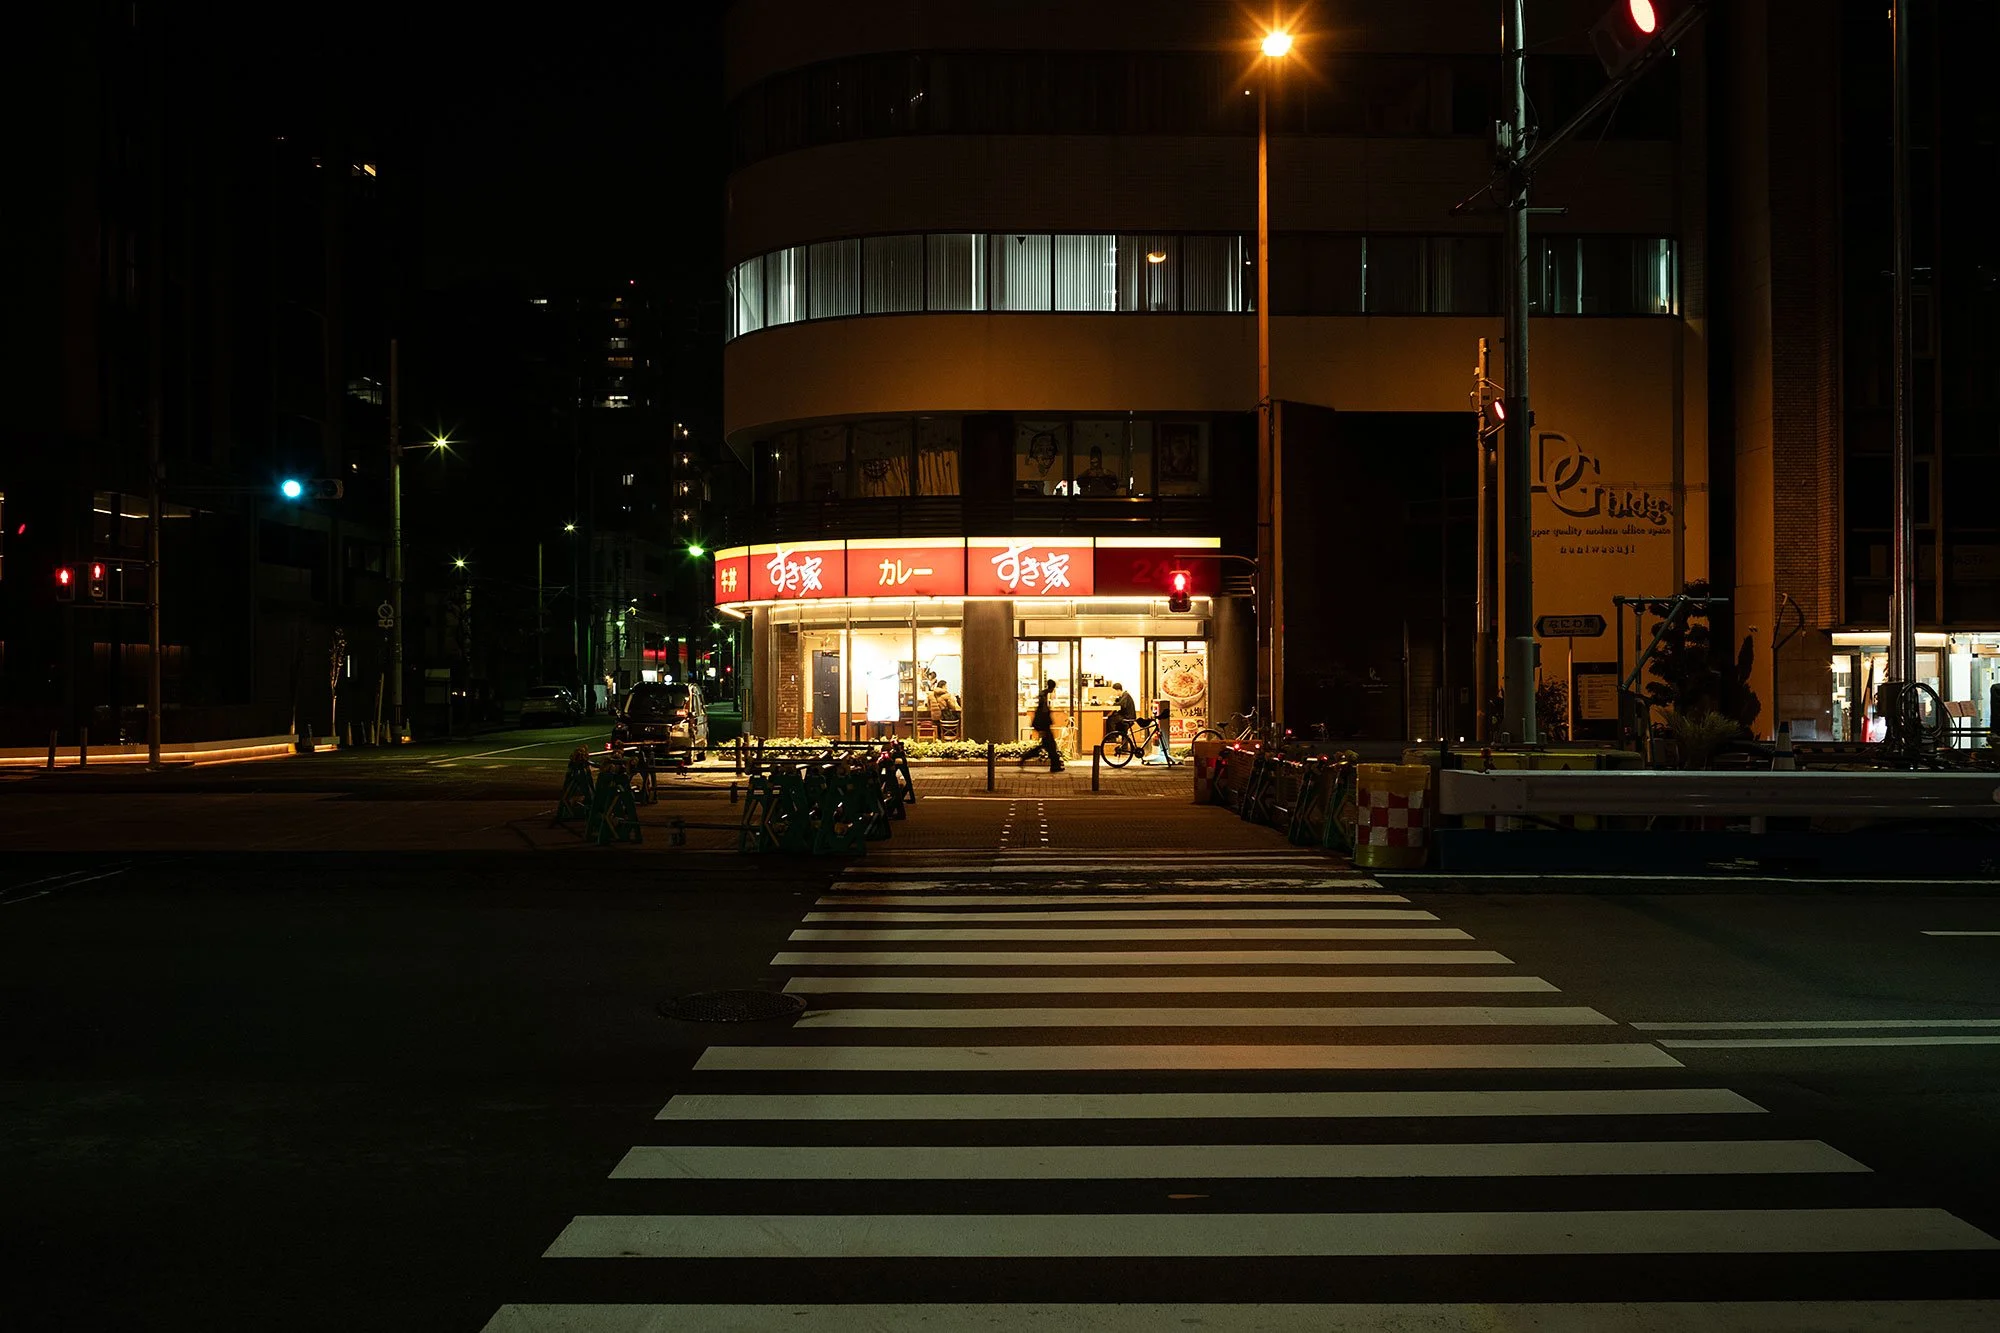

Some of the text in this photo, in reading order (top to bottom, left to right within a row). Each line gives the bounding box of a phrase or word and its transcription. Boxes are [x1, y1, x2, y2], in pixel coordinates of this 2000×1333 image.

[720, 567, 738, 593] 牛丼
[766, 543, 823, 597] すき家
[878, 558, 934, 586] カレー
[991, 540, 1071, 595] すき家
